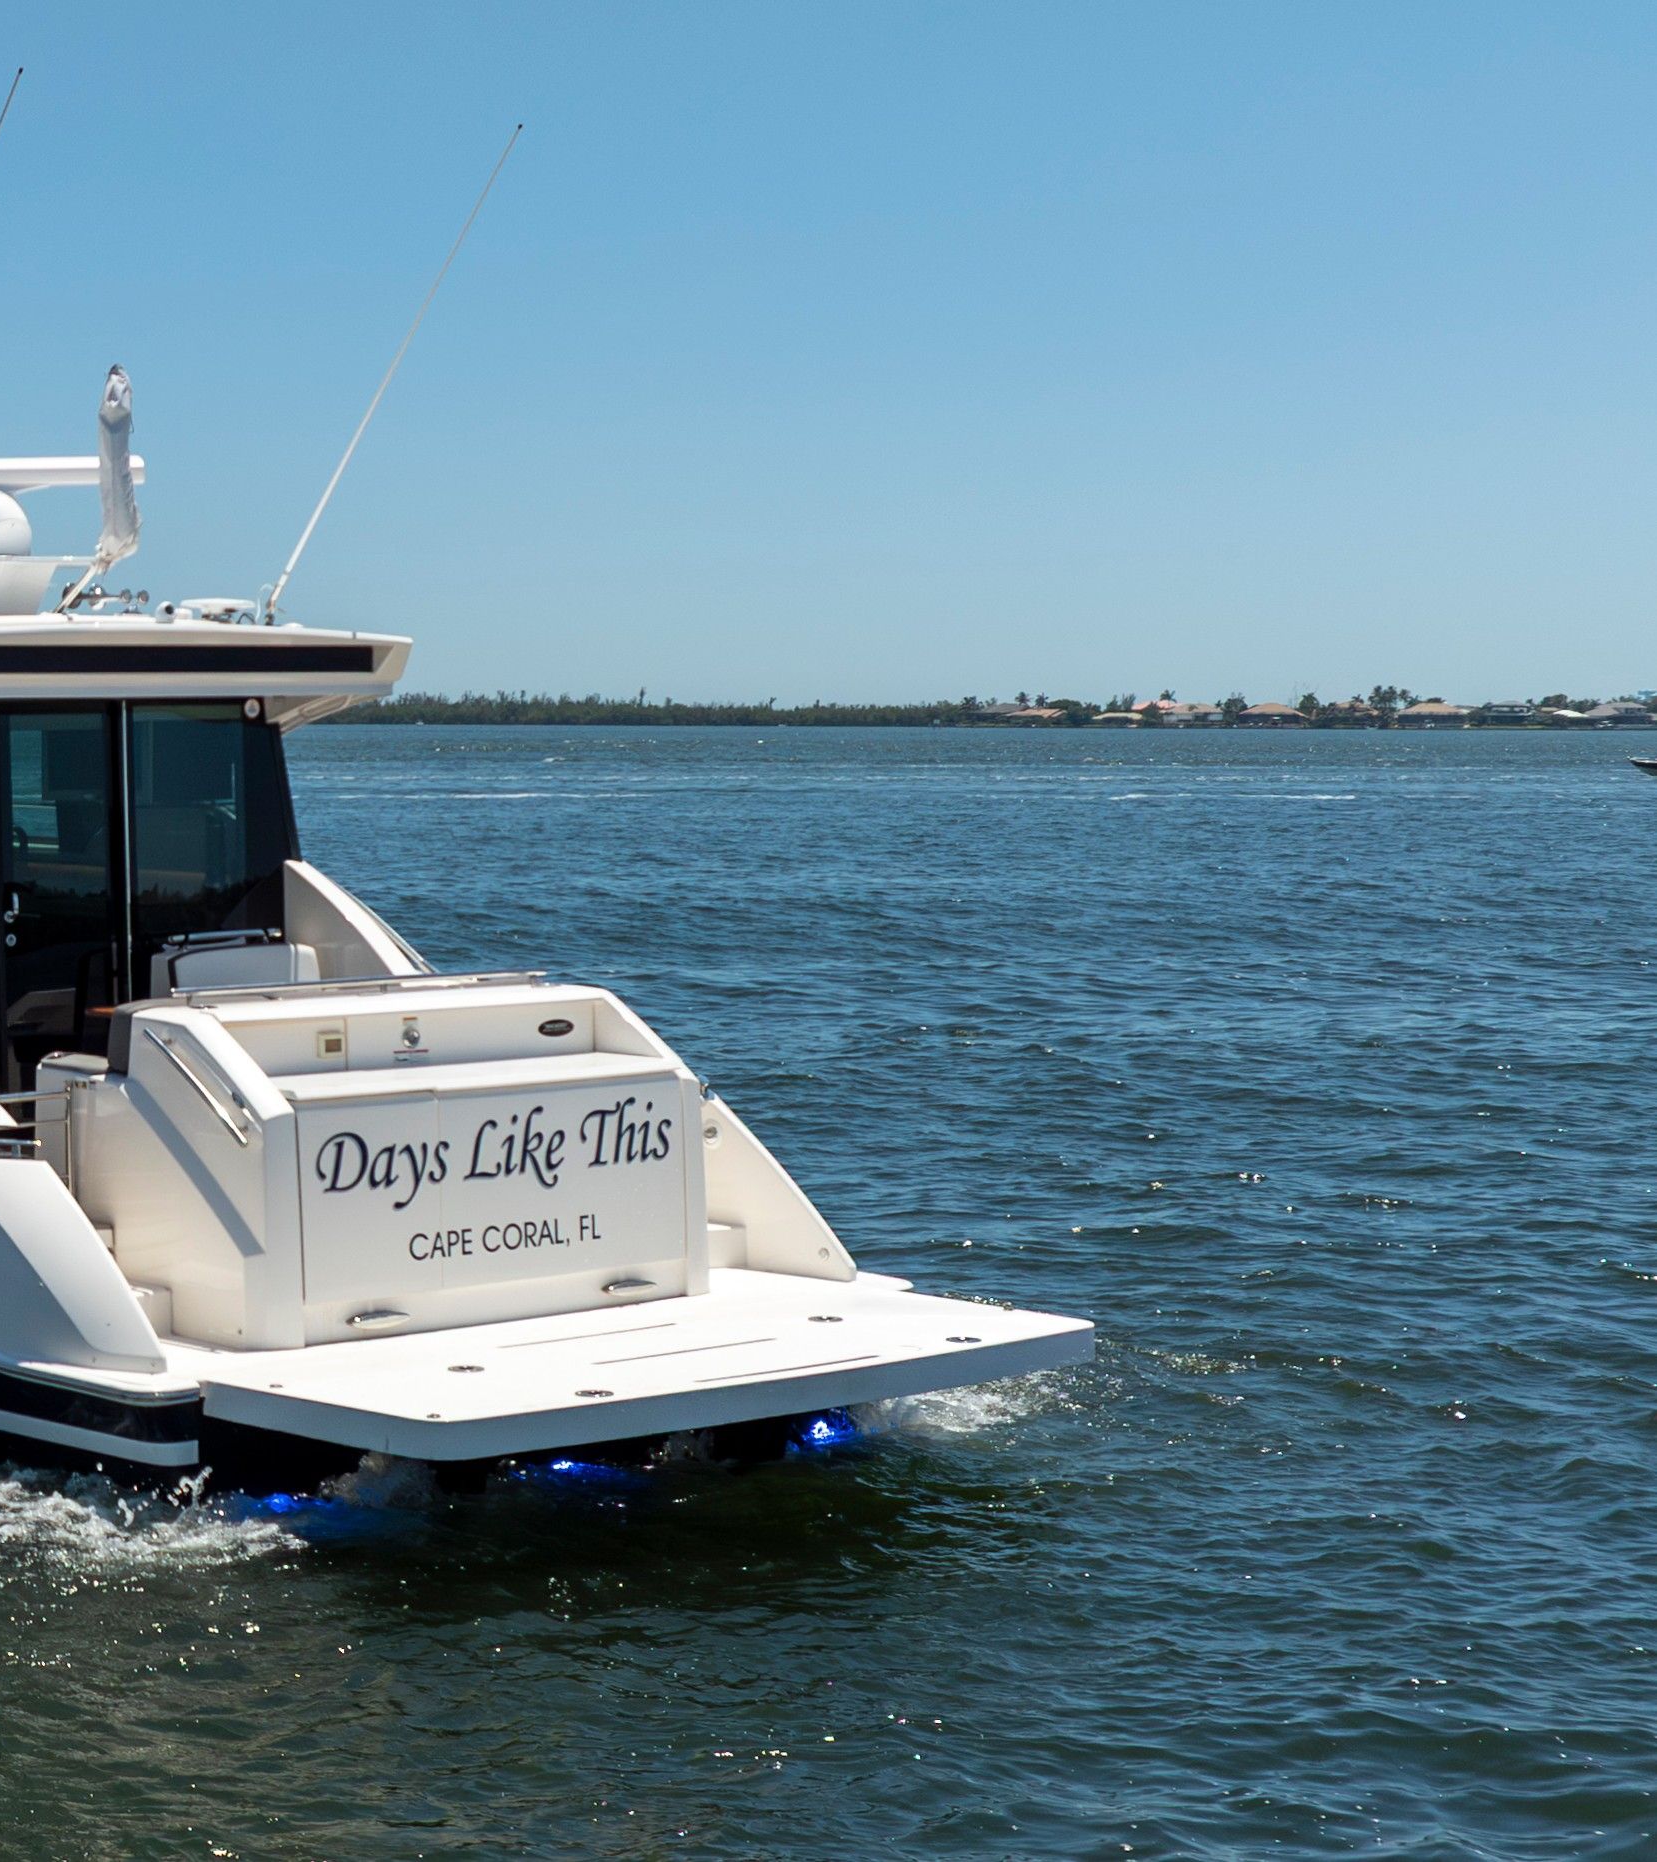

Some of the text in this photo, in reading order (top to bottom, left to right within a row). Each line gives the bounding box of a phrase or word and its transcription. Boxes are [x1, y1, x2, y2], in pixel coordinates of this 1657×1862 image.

[315, 1096, 673, 1210] Days Like This
[409, 1214, 602, 1261] CAPE CORAL, FL
